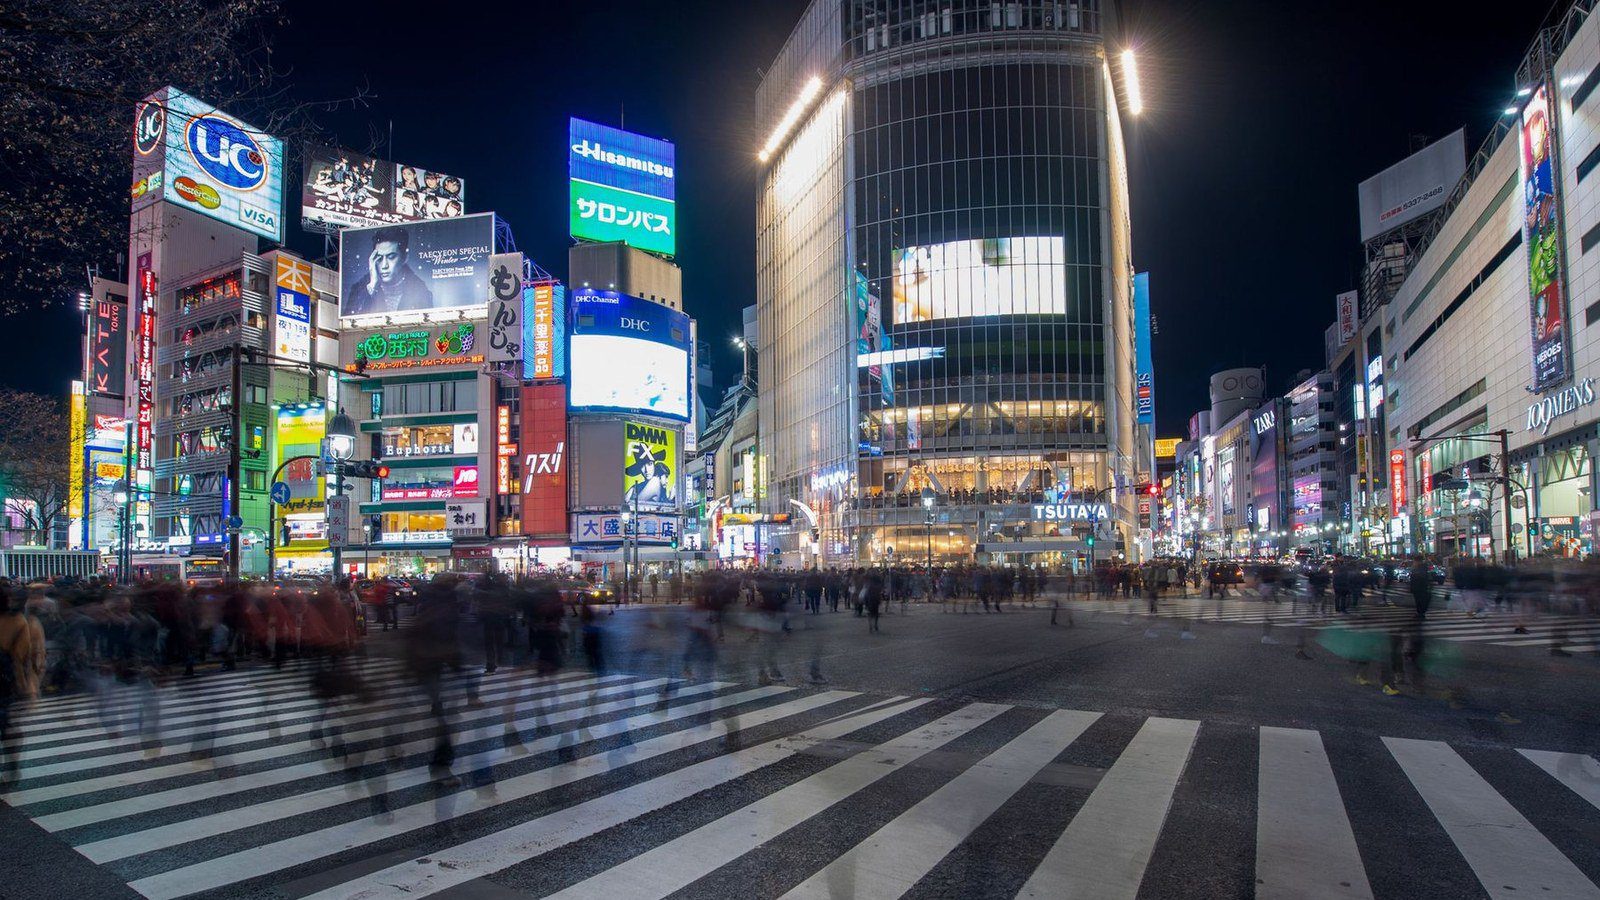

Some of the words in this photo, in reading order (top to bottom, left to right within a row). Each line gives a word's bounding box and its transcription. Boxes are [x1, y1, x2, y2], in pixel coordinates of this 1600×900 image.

[196, 123, 261, 179] UC
[571, 139, 674, 178] Hisamitsu
[244, 208, 275, 228] VISA
[576, 197, 671, 236] サロンパス
[418, 249, 458, 259] TAECYEON
[459, 246, 490, 255] SPECIAL
[277, 259, 311, 294] 本
[575, 295, 591, 303] DHC
[591, 296, 619, 304] Channel
[111, 305, 119, 332] TOKYO
[490, 264, 521, 358] もんじゃ
[620, 317, 651, 332] DHC
[387, 338, 430, 358] 西村
[1536, 342, 1562, 364] HEROES
[1138, 373, 1151, 414] SEIBU
[1253, 410, 1275, 435] ZARA
[626, 423, 668, 446] DMM
[385, 444, 451, 457] Euphoria
[626, 441, 655, 461] FX
[523, 441, 565, 494] クスリ
[1034, 504, 1108, 519] TSUTAYA
[583, 518, 674, 537] 大盛堂書店
